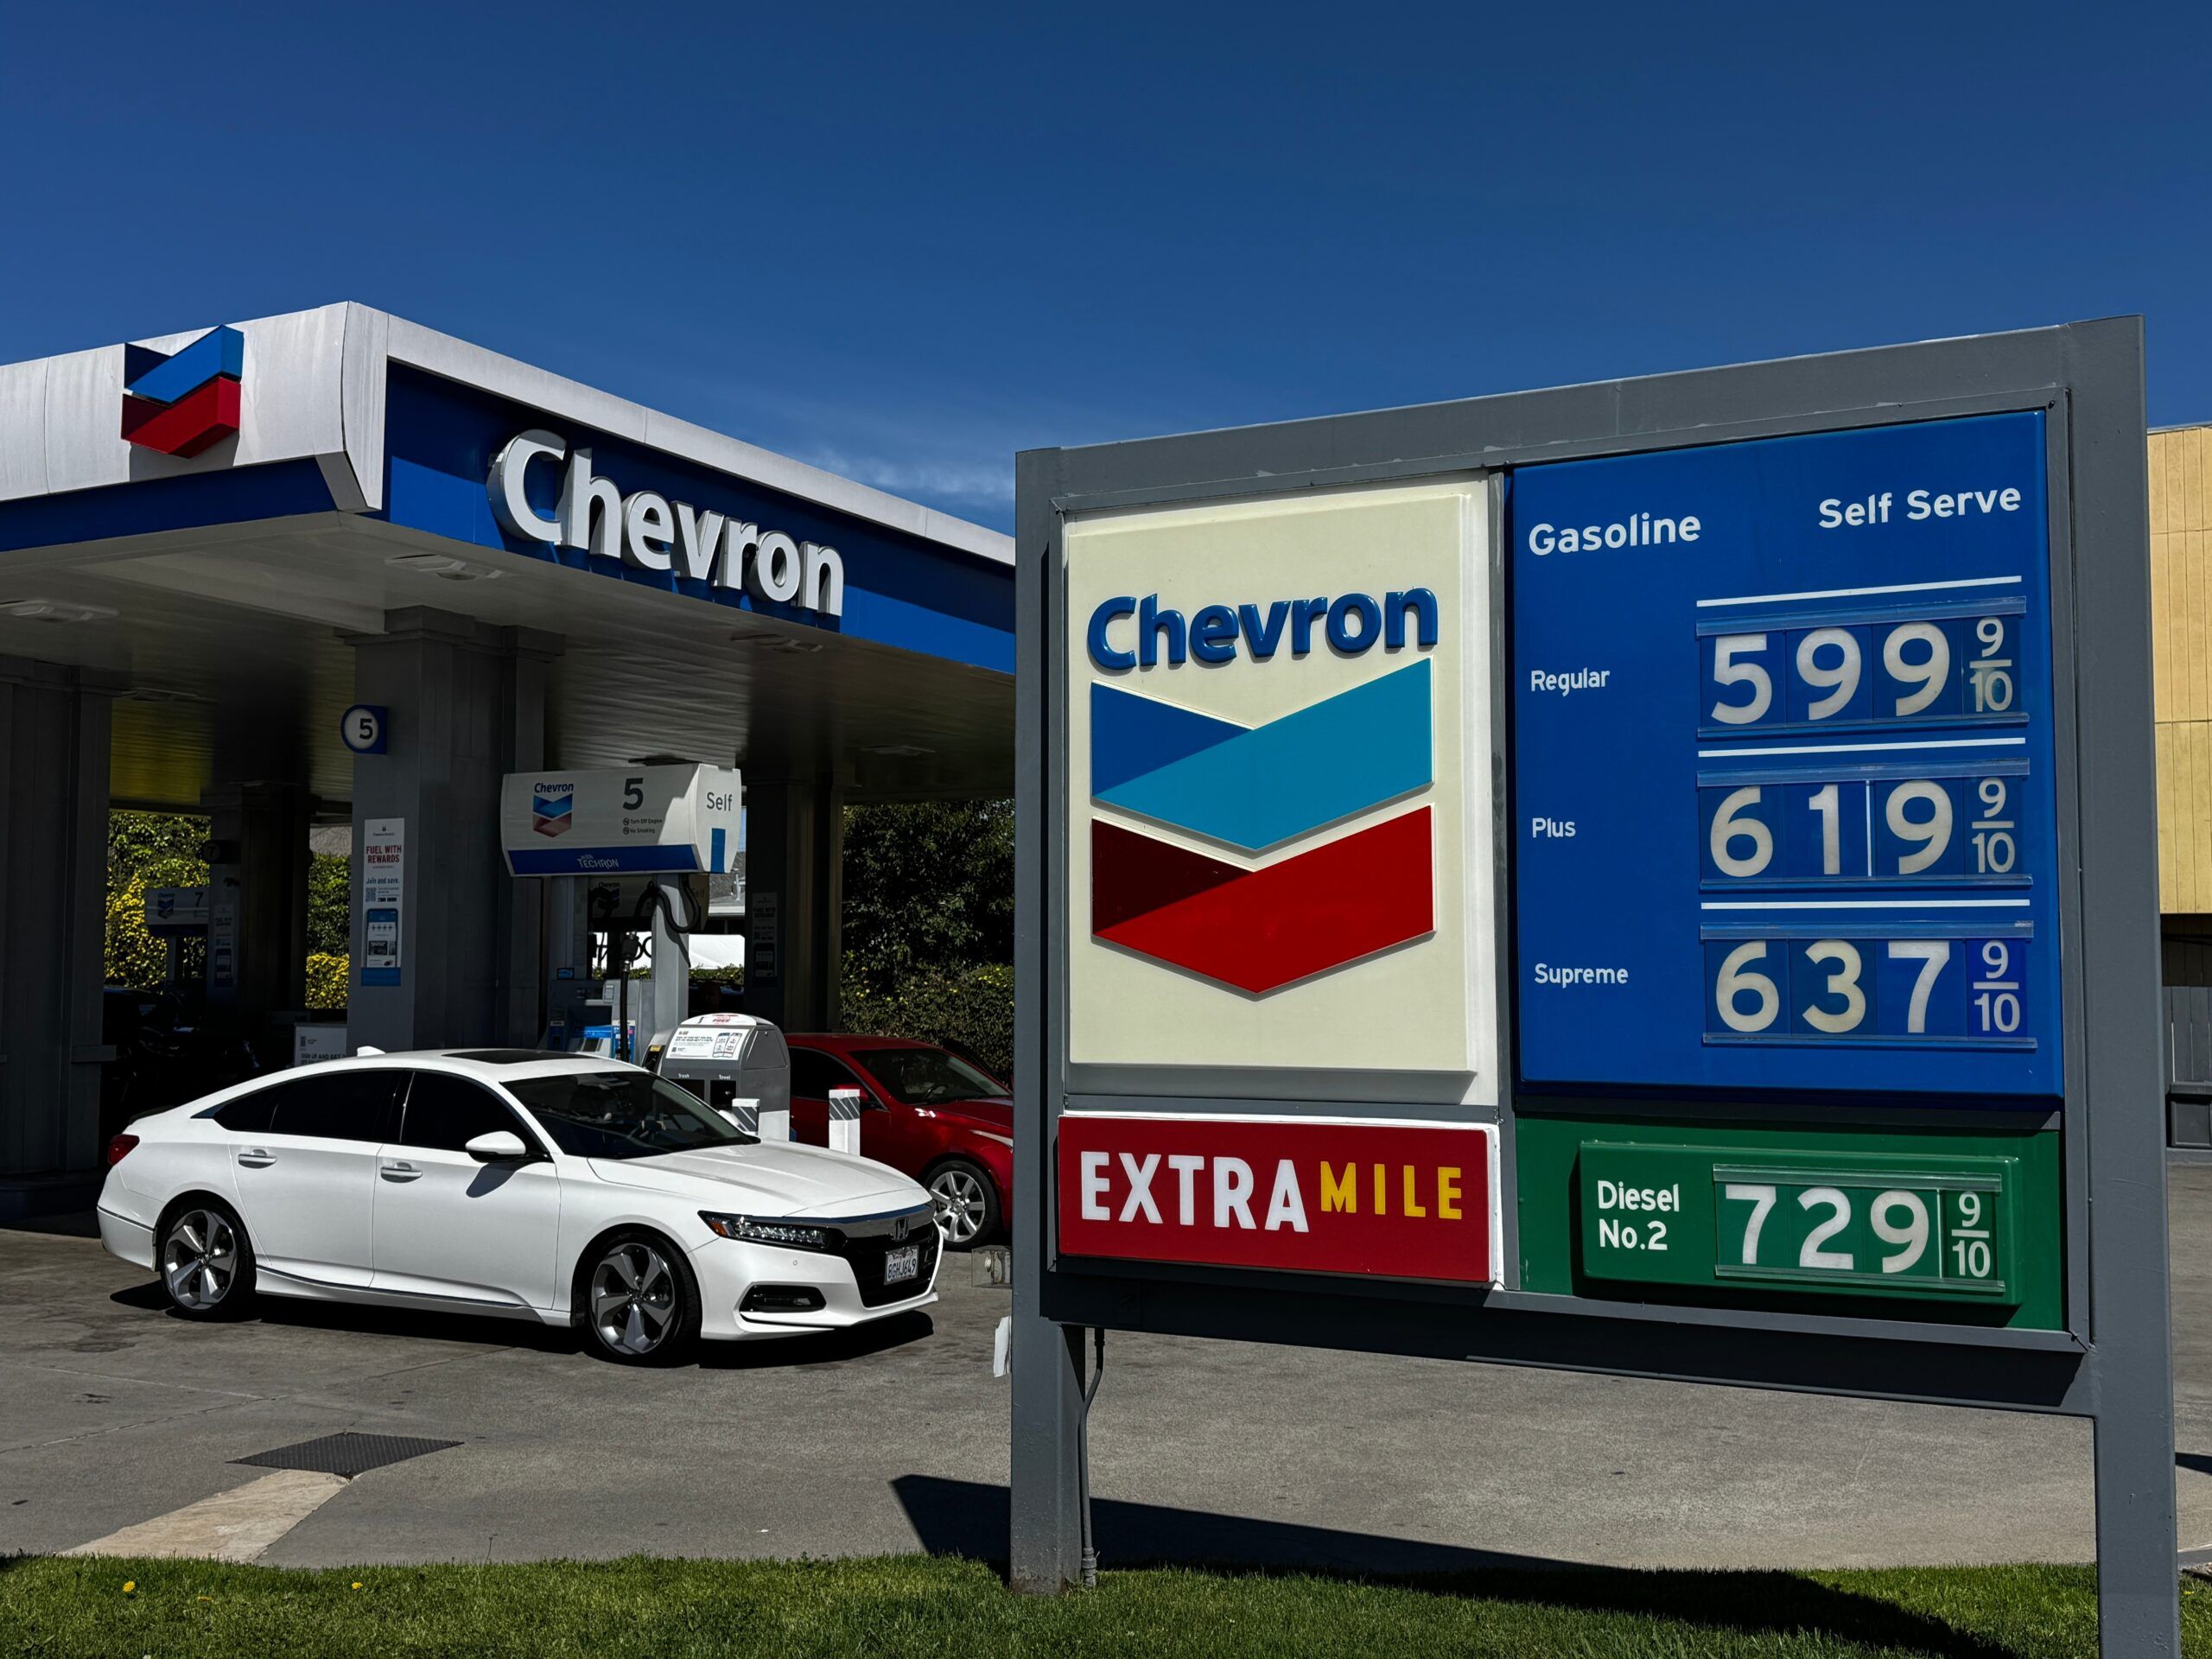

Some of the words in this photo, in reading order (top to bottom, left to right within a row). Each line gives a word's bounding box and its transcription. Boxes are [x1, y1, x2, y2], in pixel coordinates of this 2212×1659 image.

[1819, 493, 1892, 529] Self
[1906, 487, 2021, 520] Serve
[486, 429, 844, 617] Chevron
[1529, 512, 1701, 556] Gasoline
[1087, 588, 1439, 671] Chevron
[1531, 668, 1611, 697] Regular
[359, 718, 373, 740] 5
[533, 782, 575, 794] Chevron
[622, 777, 645, 811] 5
[706, 791, 733, 812] Self
[1532, 817, 1576, 838] Plus
[365, 845, 383, 855] FUEL
[385, 845, 402, 854] WITH
[367, 854, 400, 863] REWARDS
[576, 858, 620, 869] TECHRON
[1535, 963, 1629, 989] Supreme
[1598, 1179, 1680, 1212] Diesel
[1599, 1219, 1668, 1250] No.2
